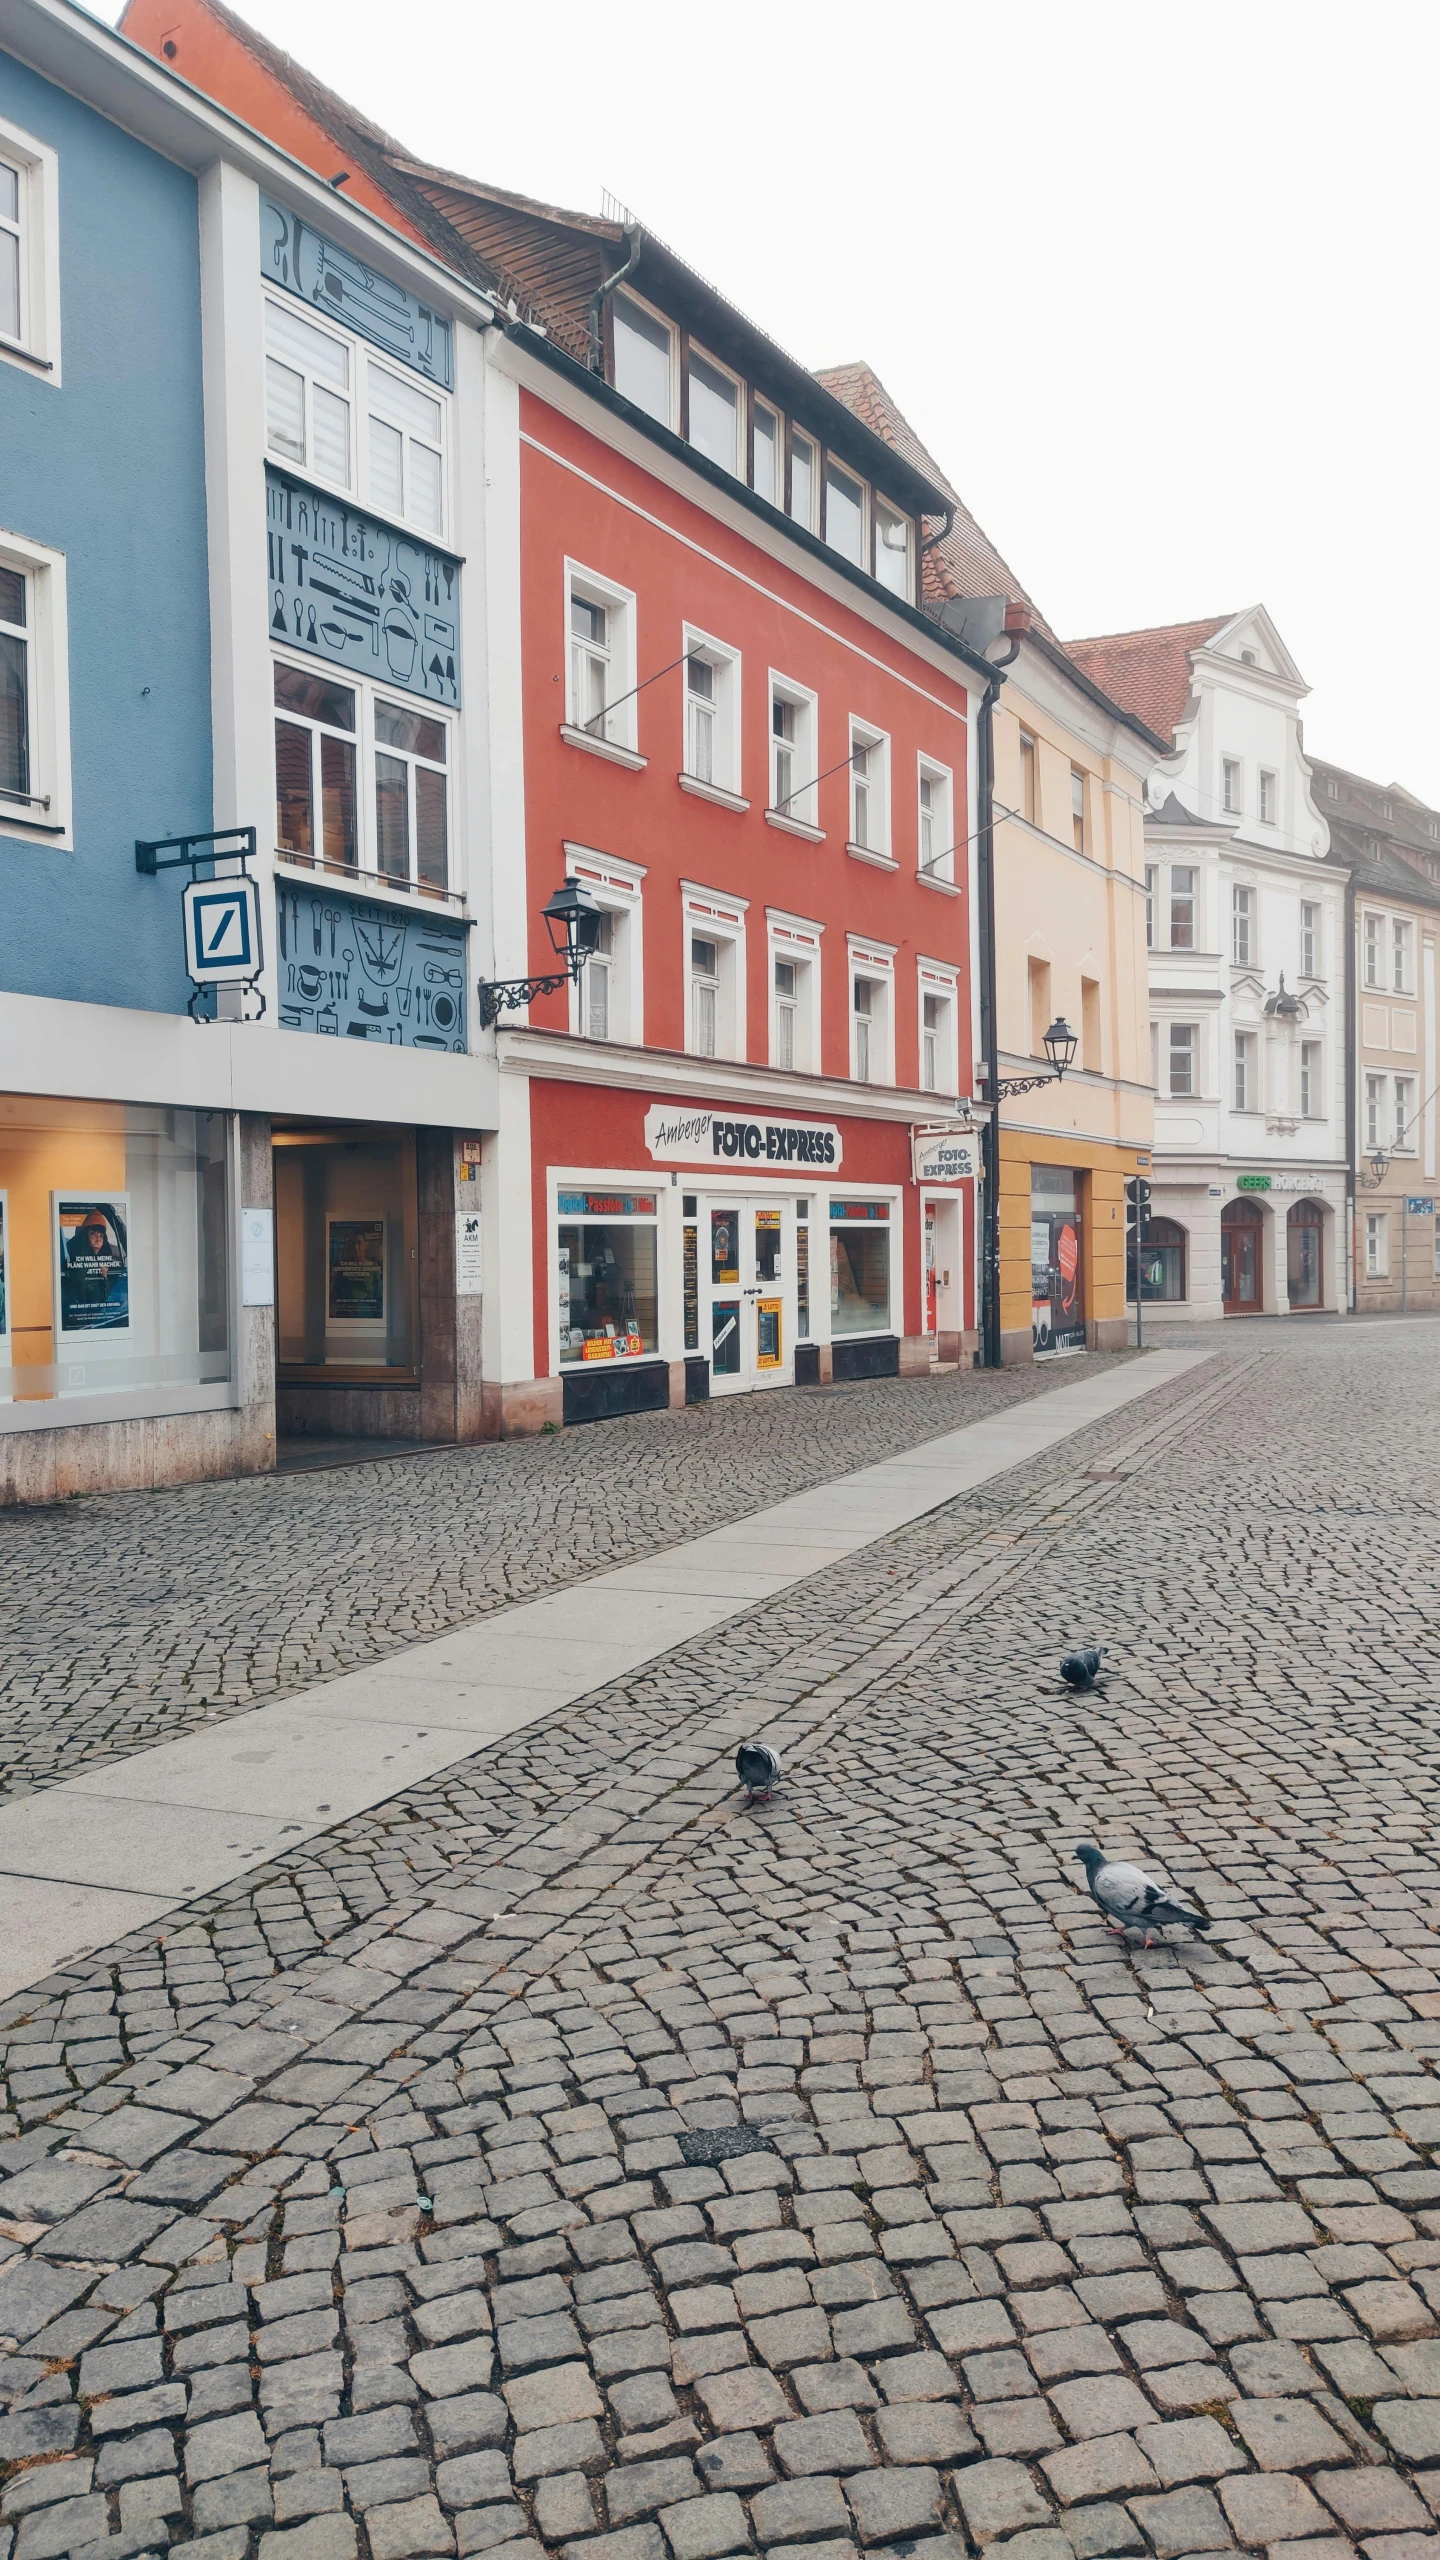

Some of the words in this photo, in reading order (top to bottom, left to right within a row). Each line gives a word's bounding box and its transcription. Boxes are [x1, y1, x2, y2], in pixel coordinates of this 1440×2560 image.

[348, 902, 382, 920] SEIT
[386, 911, 410, 926] 1870
[655, 1113, 713, 1148] Amberger
[713, 1121, 835, 1164] FOTO-EXPRESS
[919, 1138, 948, 1159] Amberger
[938, 1149, 971, 1162] FOTO-
[923, 1162, 972, 1177] EXPRESS
[1242, 1177, 1271, 1189] GEERS
[464, 1234, 478, 1242] AKM
